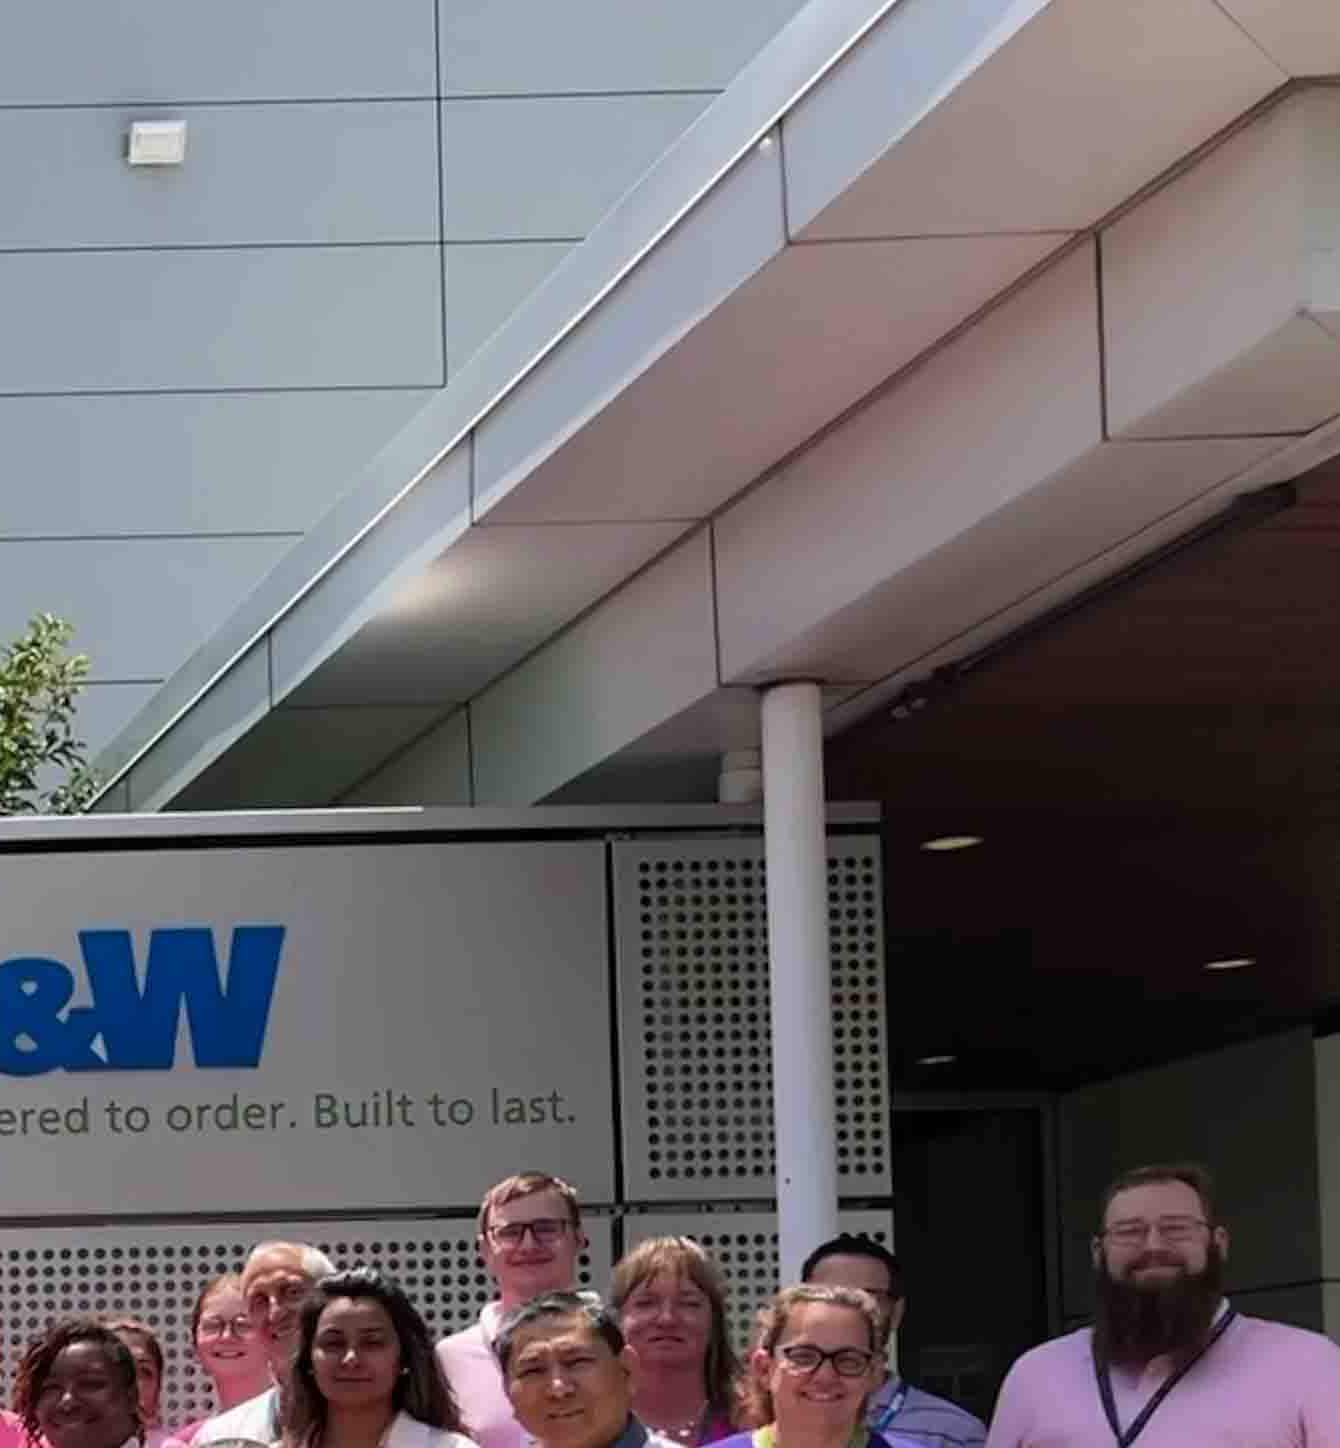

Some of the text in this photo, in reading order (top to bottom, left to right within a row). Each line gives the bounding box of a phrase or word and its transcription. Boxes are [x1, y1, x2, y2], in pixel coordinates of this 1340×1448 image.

[104, 1100, 151, 1134] to
[166, 1092, 297, 1132] order.
[314, 1088, 415, 1129] Built
[427, 1092, 475, 1127] to
[491, 1086, 576, 1126] last.
